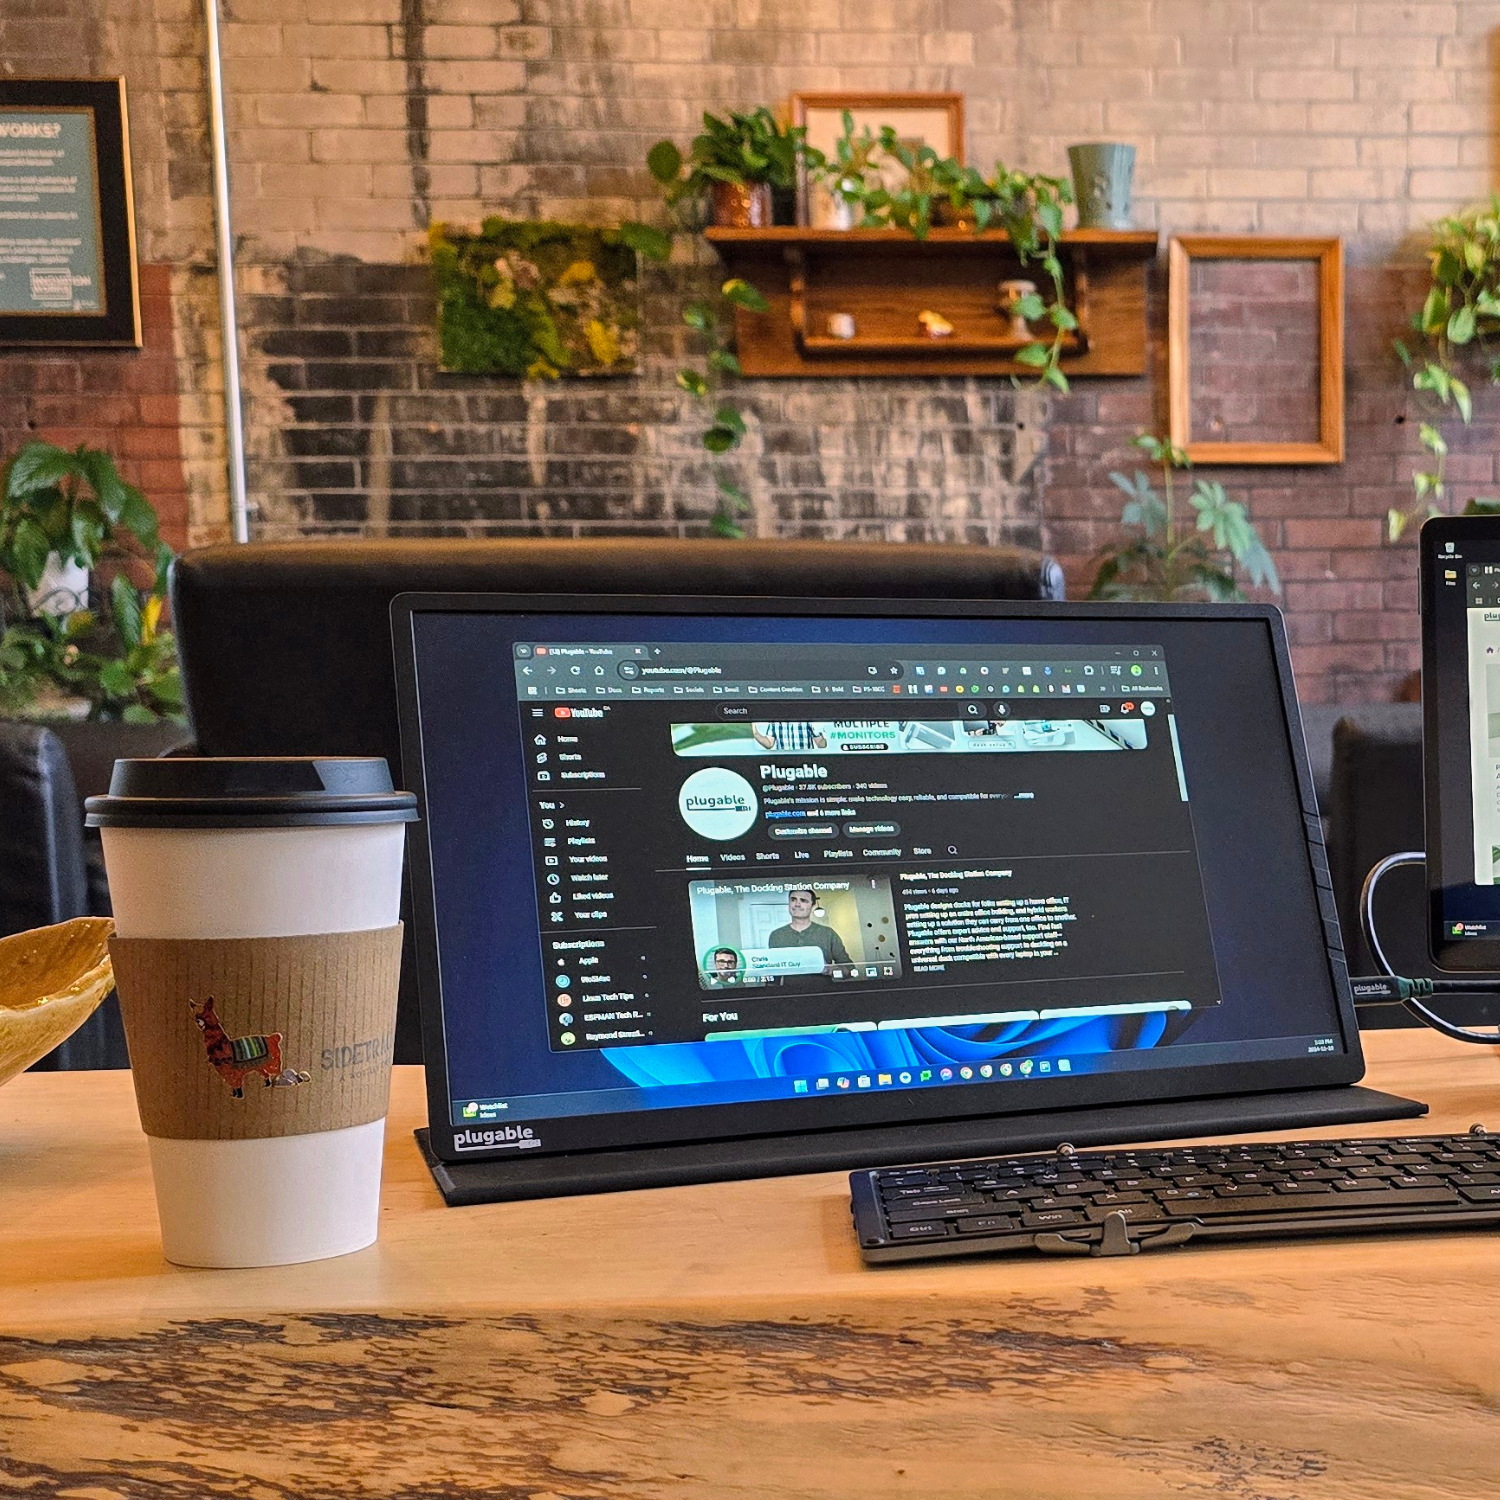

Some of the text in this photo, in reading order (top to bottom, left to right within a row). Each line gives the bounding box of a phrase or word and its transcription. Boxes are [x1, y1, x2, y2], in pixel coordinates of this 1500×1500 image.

[570, 708, 603, 718] YouTube
[724, 707, 748, 715] Search
[830, 731, 896, 740] #MONITORS
[760, 763, 828, 781] Plugable
[539, 801, 555, 810] You
[686, 795, 745, 808] plugable
[686, 847, 932, 864] Home Videos Shorts Live Playlists Community Store
[697, 880, 850, 895] Plugable, The Docking Station Company
[552, 940, 605, 950] Subscriptions
[1354, 983, 1387, 994] plugable
[702, 1011, 738, 1023] For You
[453, 1125, 534, 1147] plugable
